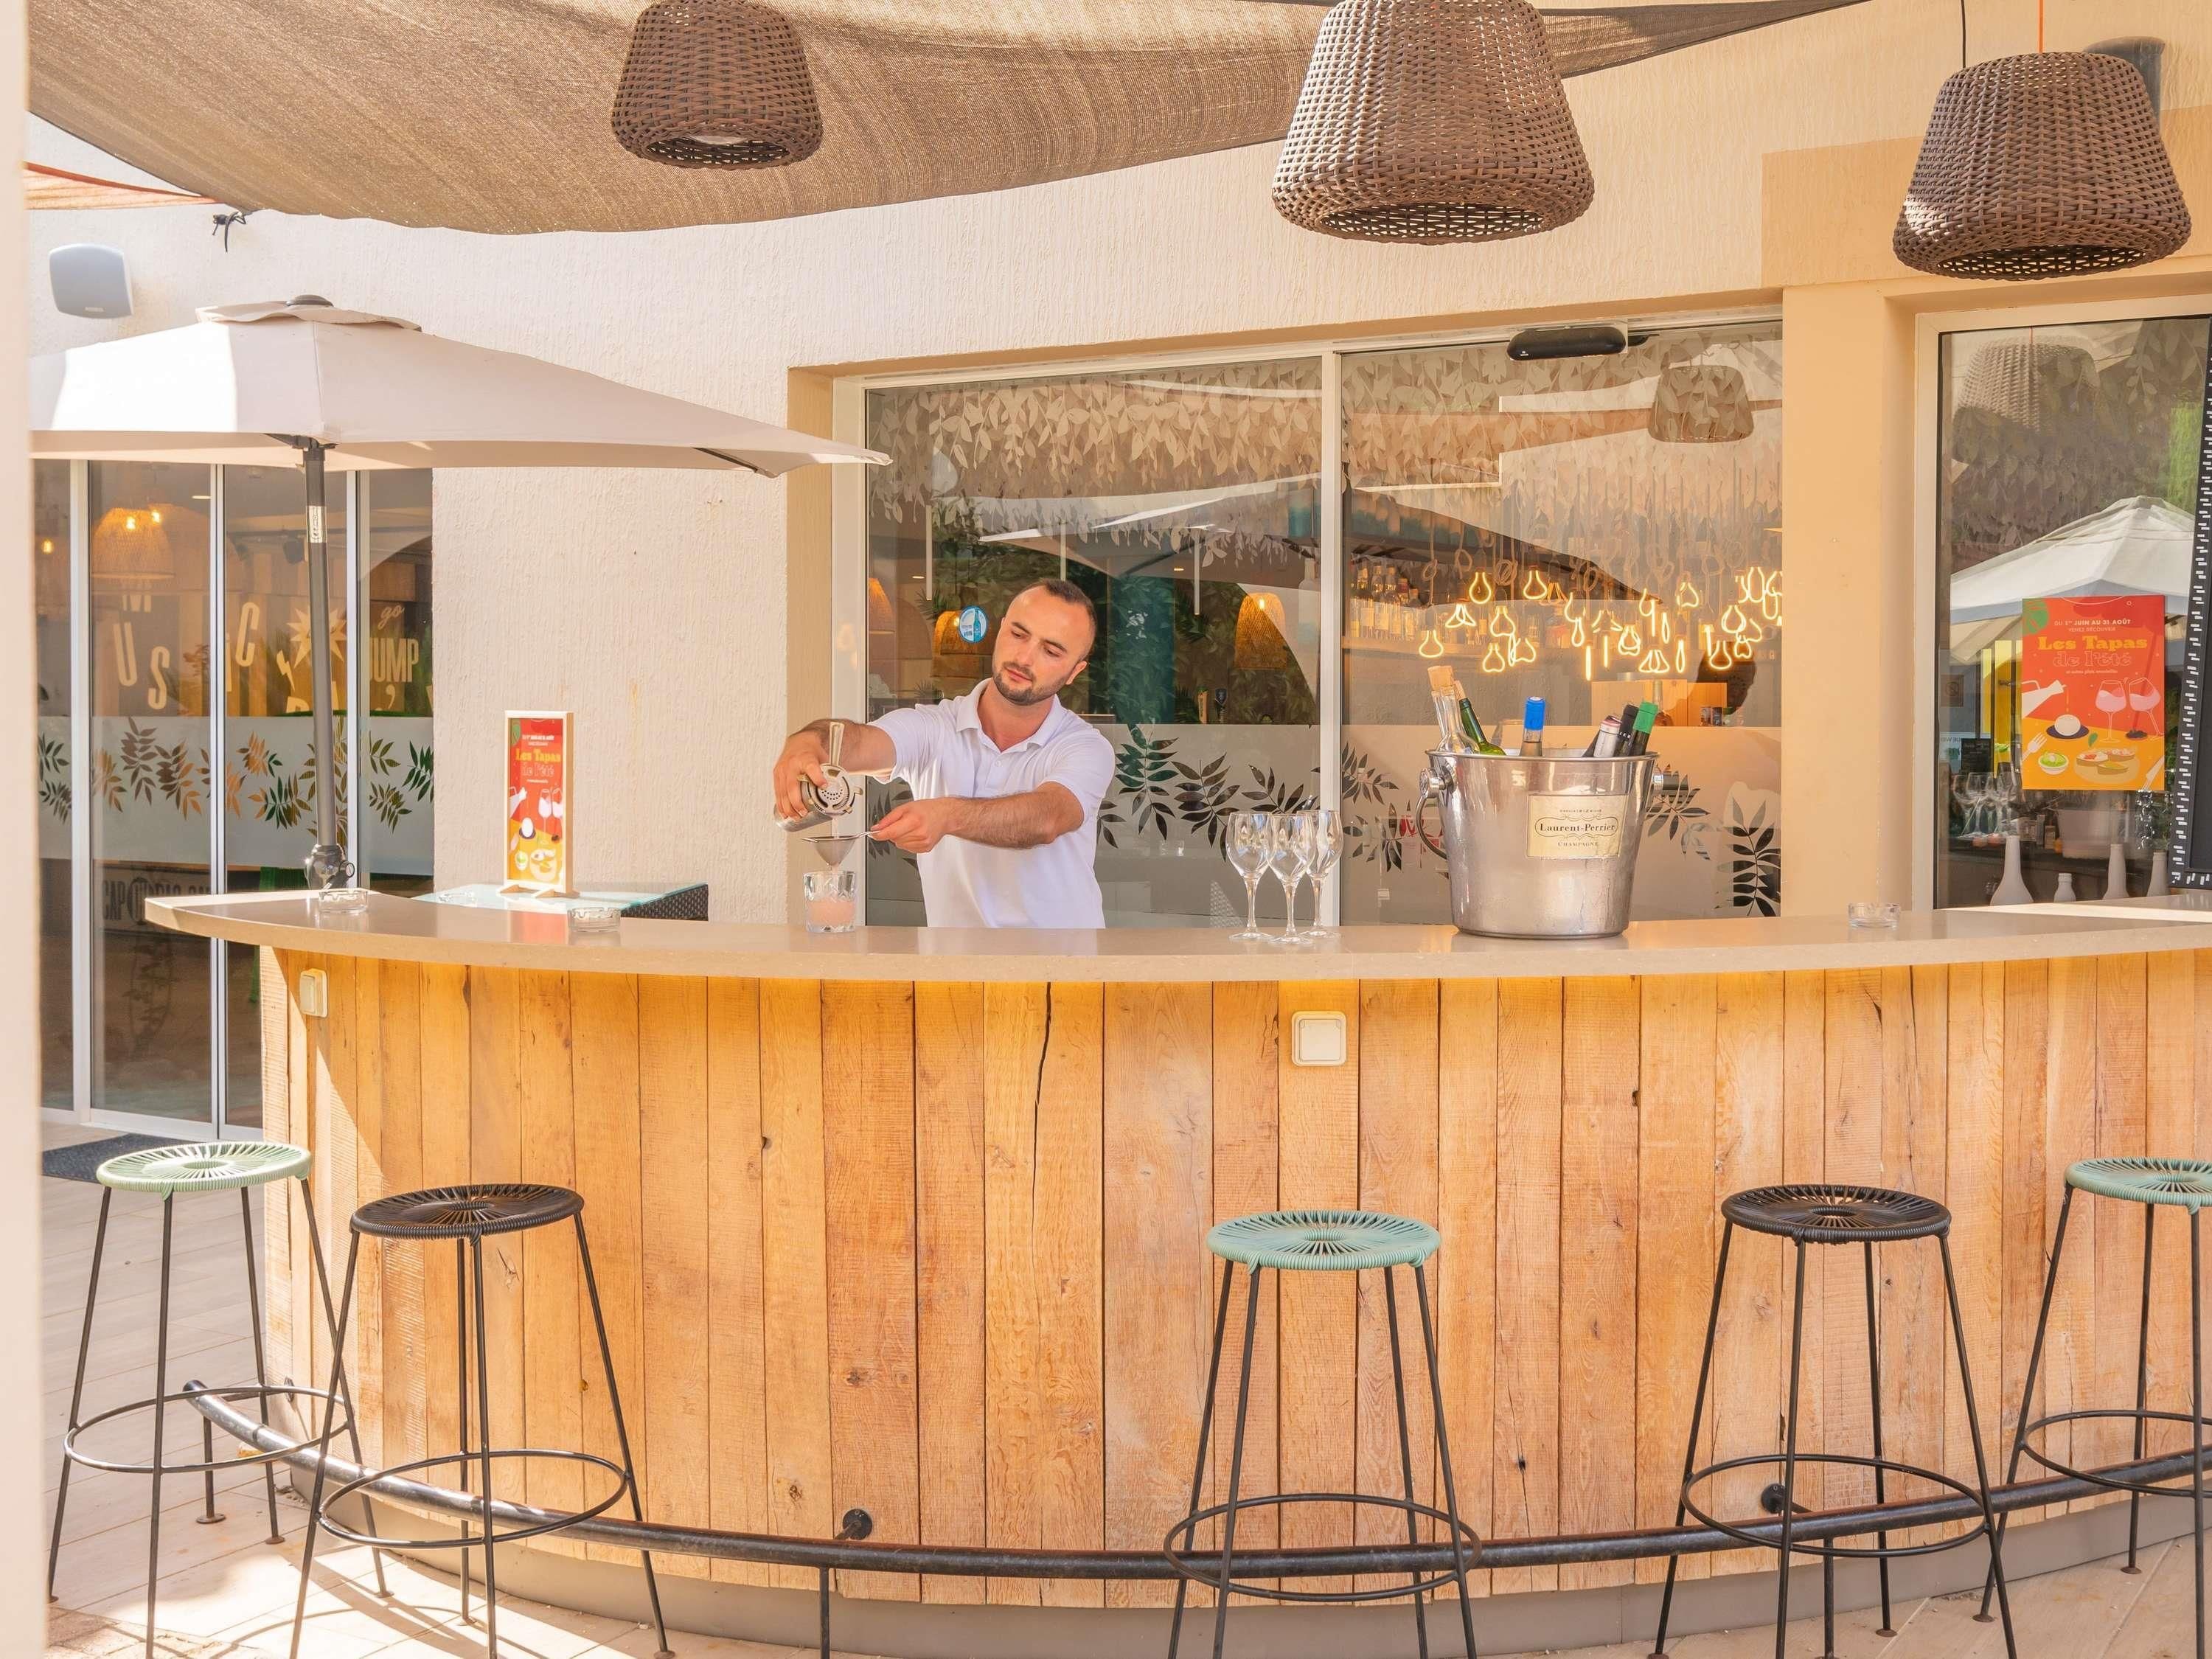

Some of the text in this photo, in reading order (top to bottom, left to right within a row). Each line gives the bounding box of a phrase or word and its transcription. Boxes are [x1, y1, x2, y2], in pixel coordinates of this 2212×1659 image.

[378, 605, 404, 630] go
[2037, 635, 2149, 652] Les Tapas
[2052, 650, 2080, 667] de
[515, 748, 561, 765] Les Tapas
[1540, 823, 1615, 832] Laurent-Perrier
